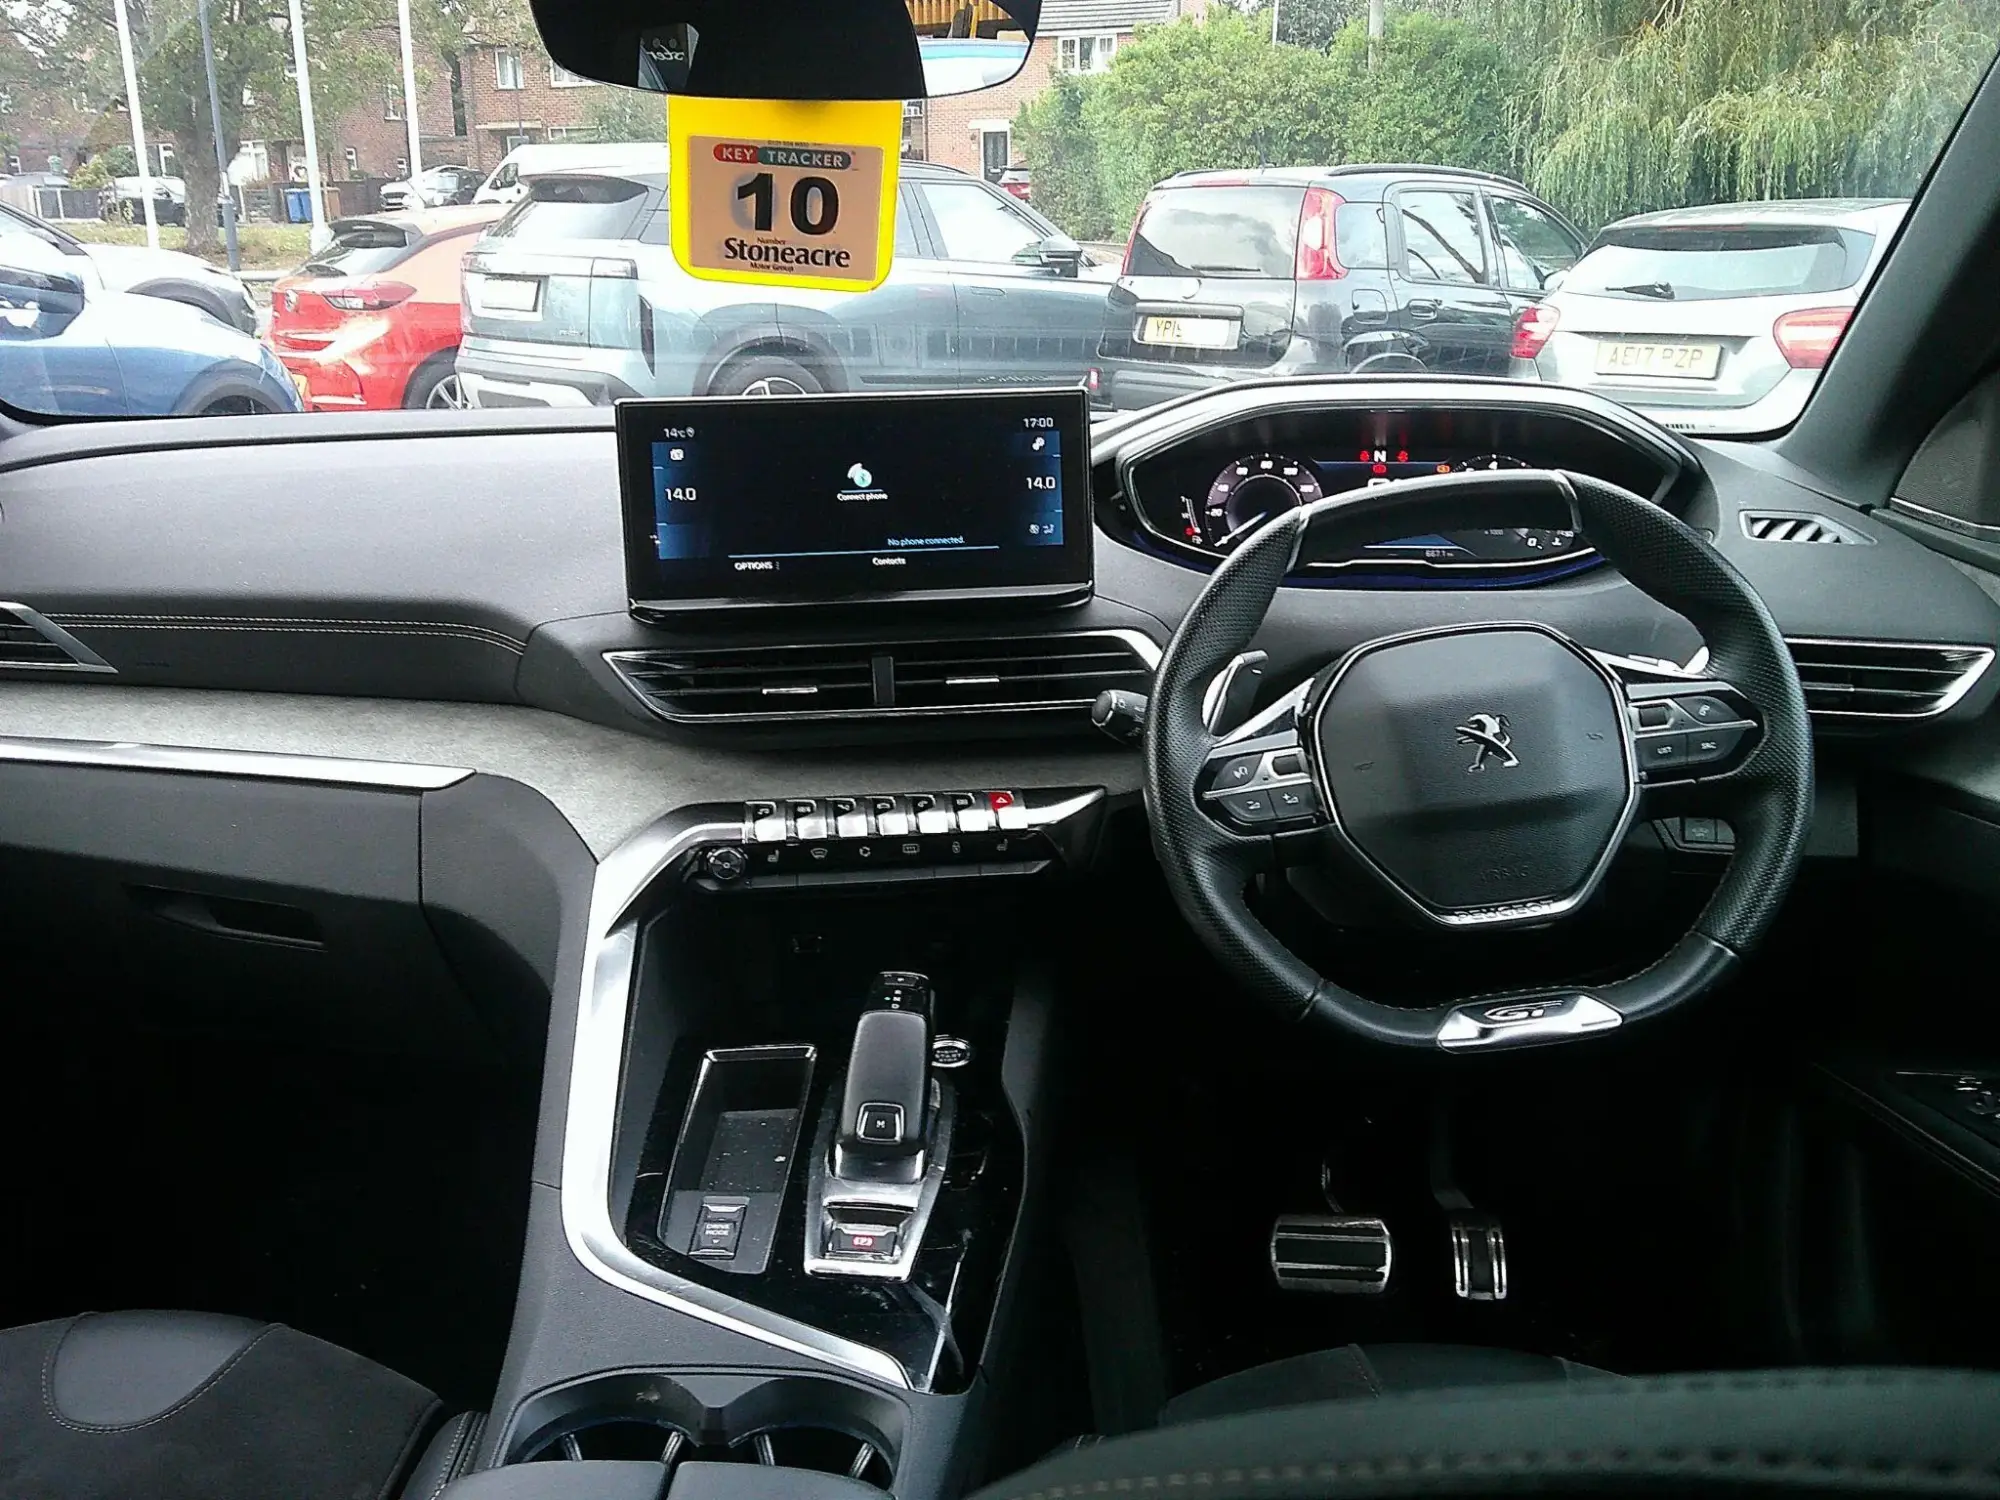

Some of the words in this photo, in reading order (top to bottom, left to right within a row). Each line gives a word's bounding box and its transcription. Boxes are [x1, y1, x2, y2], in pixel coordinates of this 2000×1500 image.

[721, 147, 754, 161] KEY
[766, 150, 844, 168] TRACKER
[736, 172, 840, 236] 10
[723, 237, 851, 268] Stoneacre
[750, 262, 772, 271] Motor
[772, 264, 794, 273] Group
[1607, 346, 1655, 367] AE17
[1023, 417, 1054, 428] 17:00
[1373, 450, 1387, 462] N
[1026, 476, 1056, 489] 14.0
[664, 487, 697, 501] 14.0
[837, 492, 865, 502] Connect
[865, 492, 888, 502] phone
[887, 538, 899, 546] No
[900, 537, 924, 547] phone
[734, 561, 774, 570] OPTIONS
[872, 557, 906, 566] Contacts
